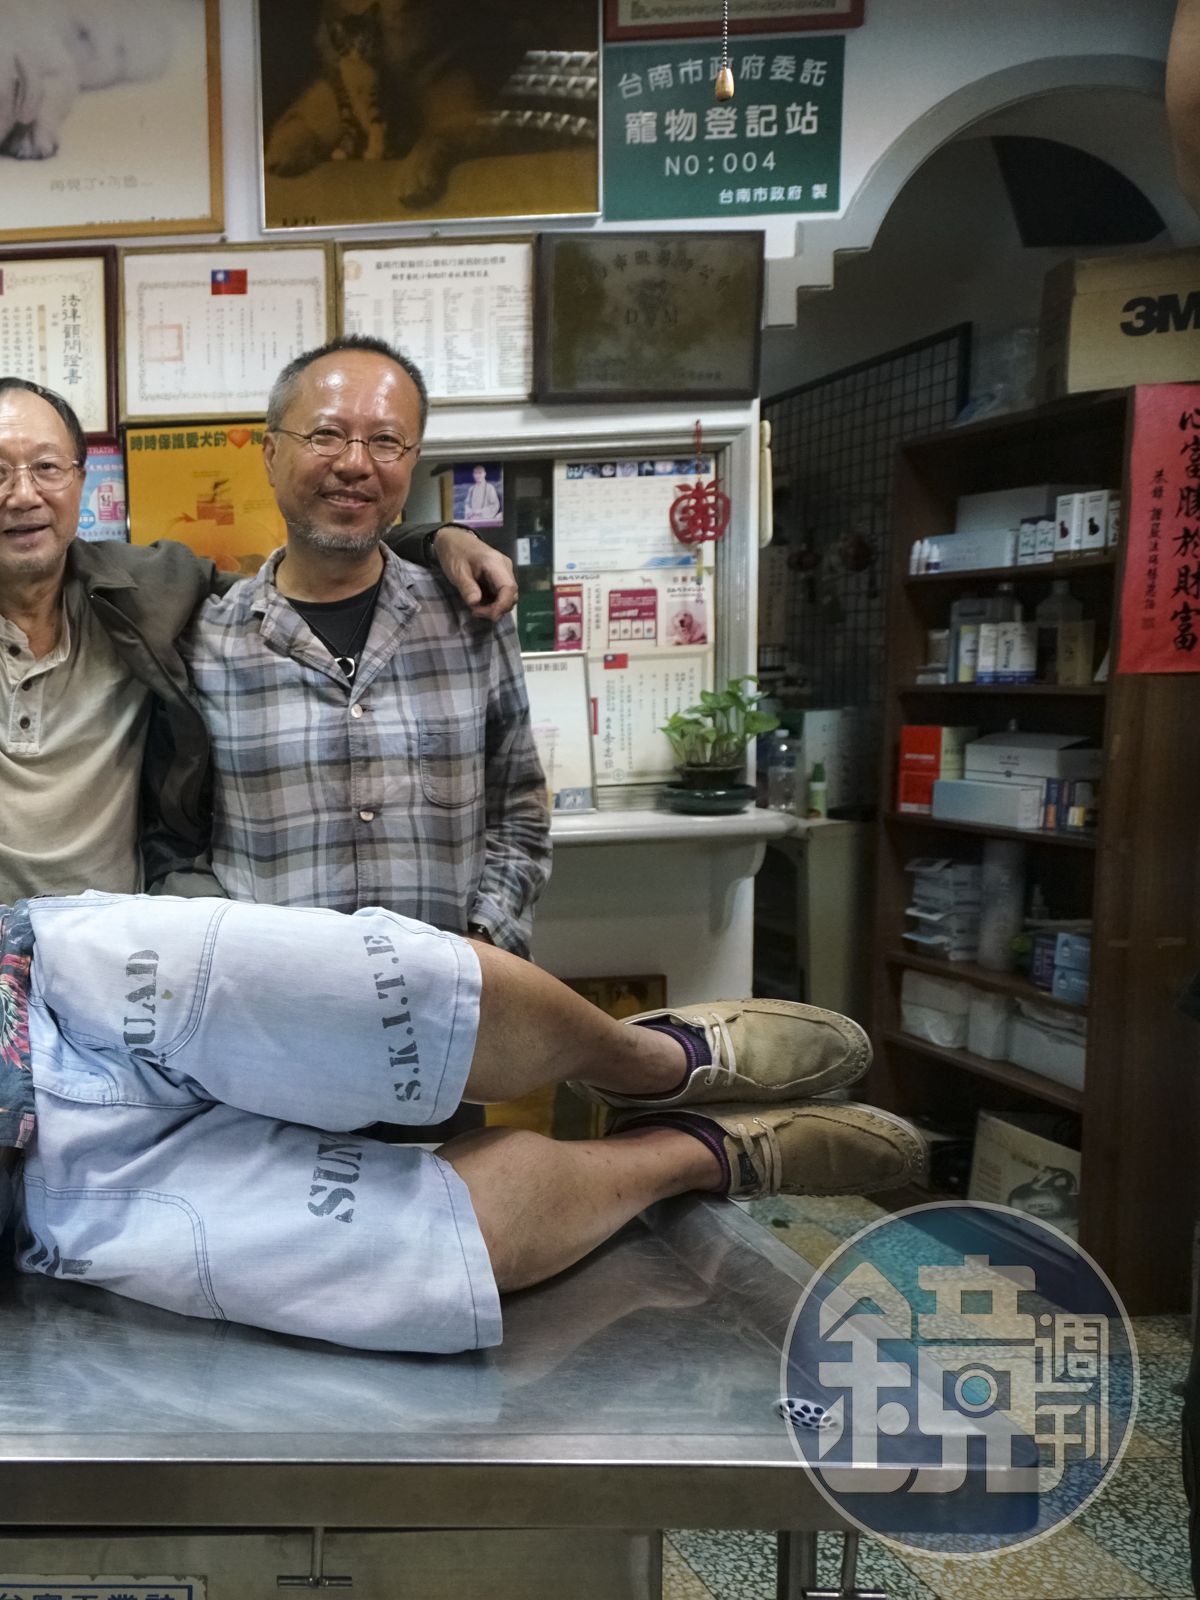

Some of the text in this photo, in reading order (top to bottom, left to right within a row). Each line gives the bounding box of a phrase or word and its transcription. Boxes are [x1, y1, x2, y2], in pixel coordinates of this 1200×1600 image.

[618, 54, 828, 99] 台南市政府委託
[625, 102, 819, 145] 寵物登記站
[665, 151, 776, 176] NO:004
[719, 186, 802, 204] 台南市政府
[1120, 291, 1200, 336] 3M
